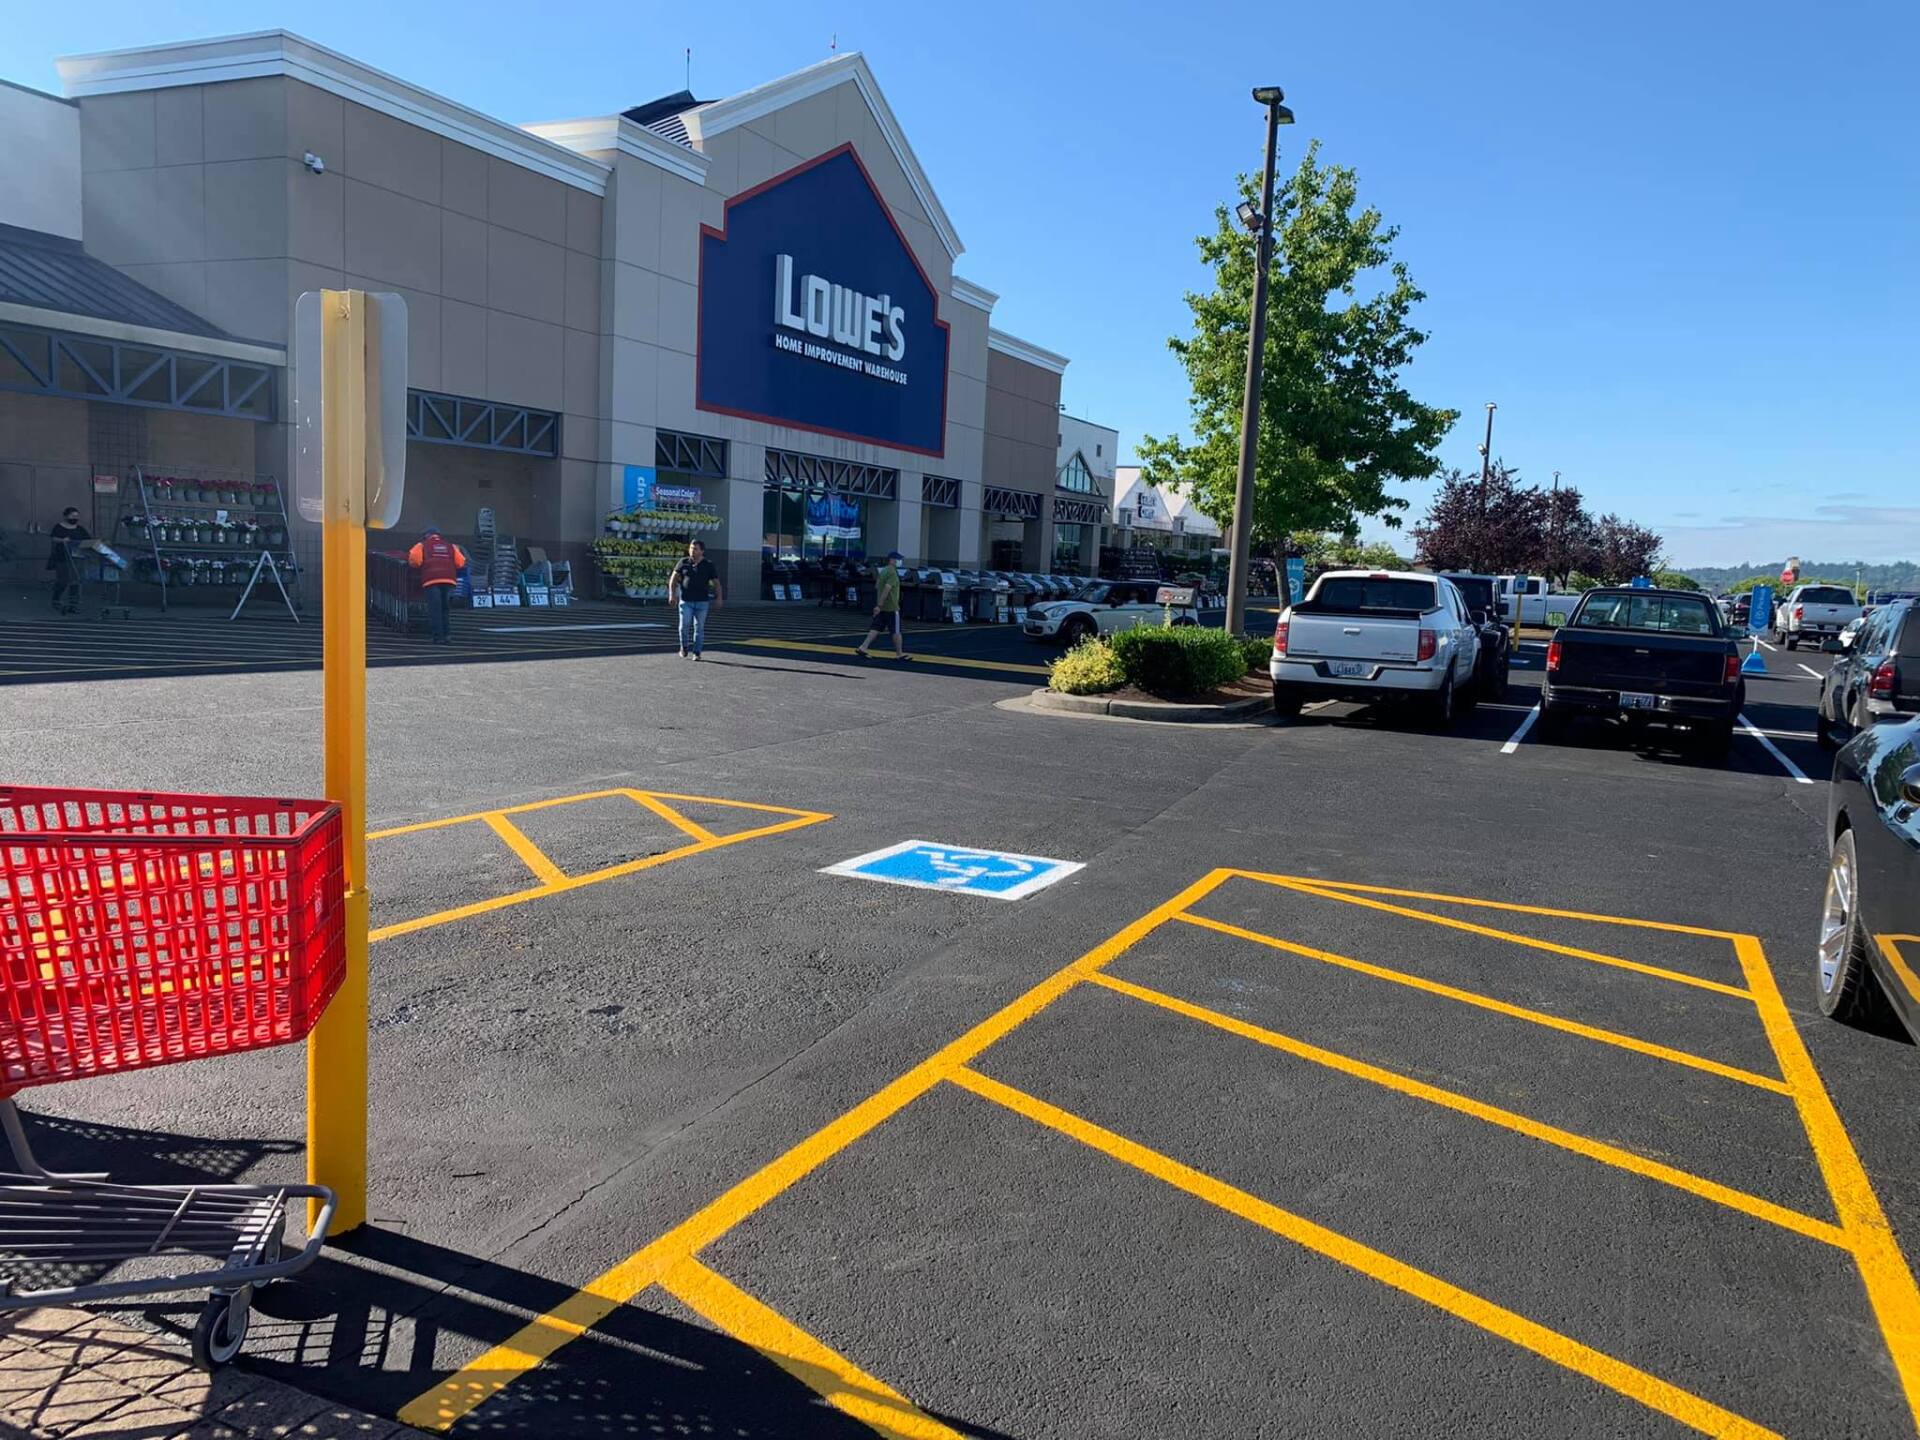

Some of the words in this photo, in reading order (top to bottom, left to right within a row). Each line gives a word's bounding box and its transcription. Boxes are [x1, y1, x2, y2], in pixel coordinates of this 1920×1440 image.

[774, 253, 906, 362] LOWE'S
[775, 334, 803, 354] HOME
[804, 343, 863, 373] IMPROVEMENT
[864, 361, 908, 385] WAREHOUSE
